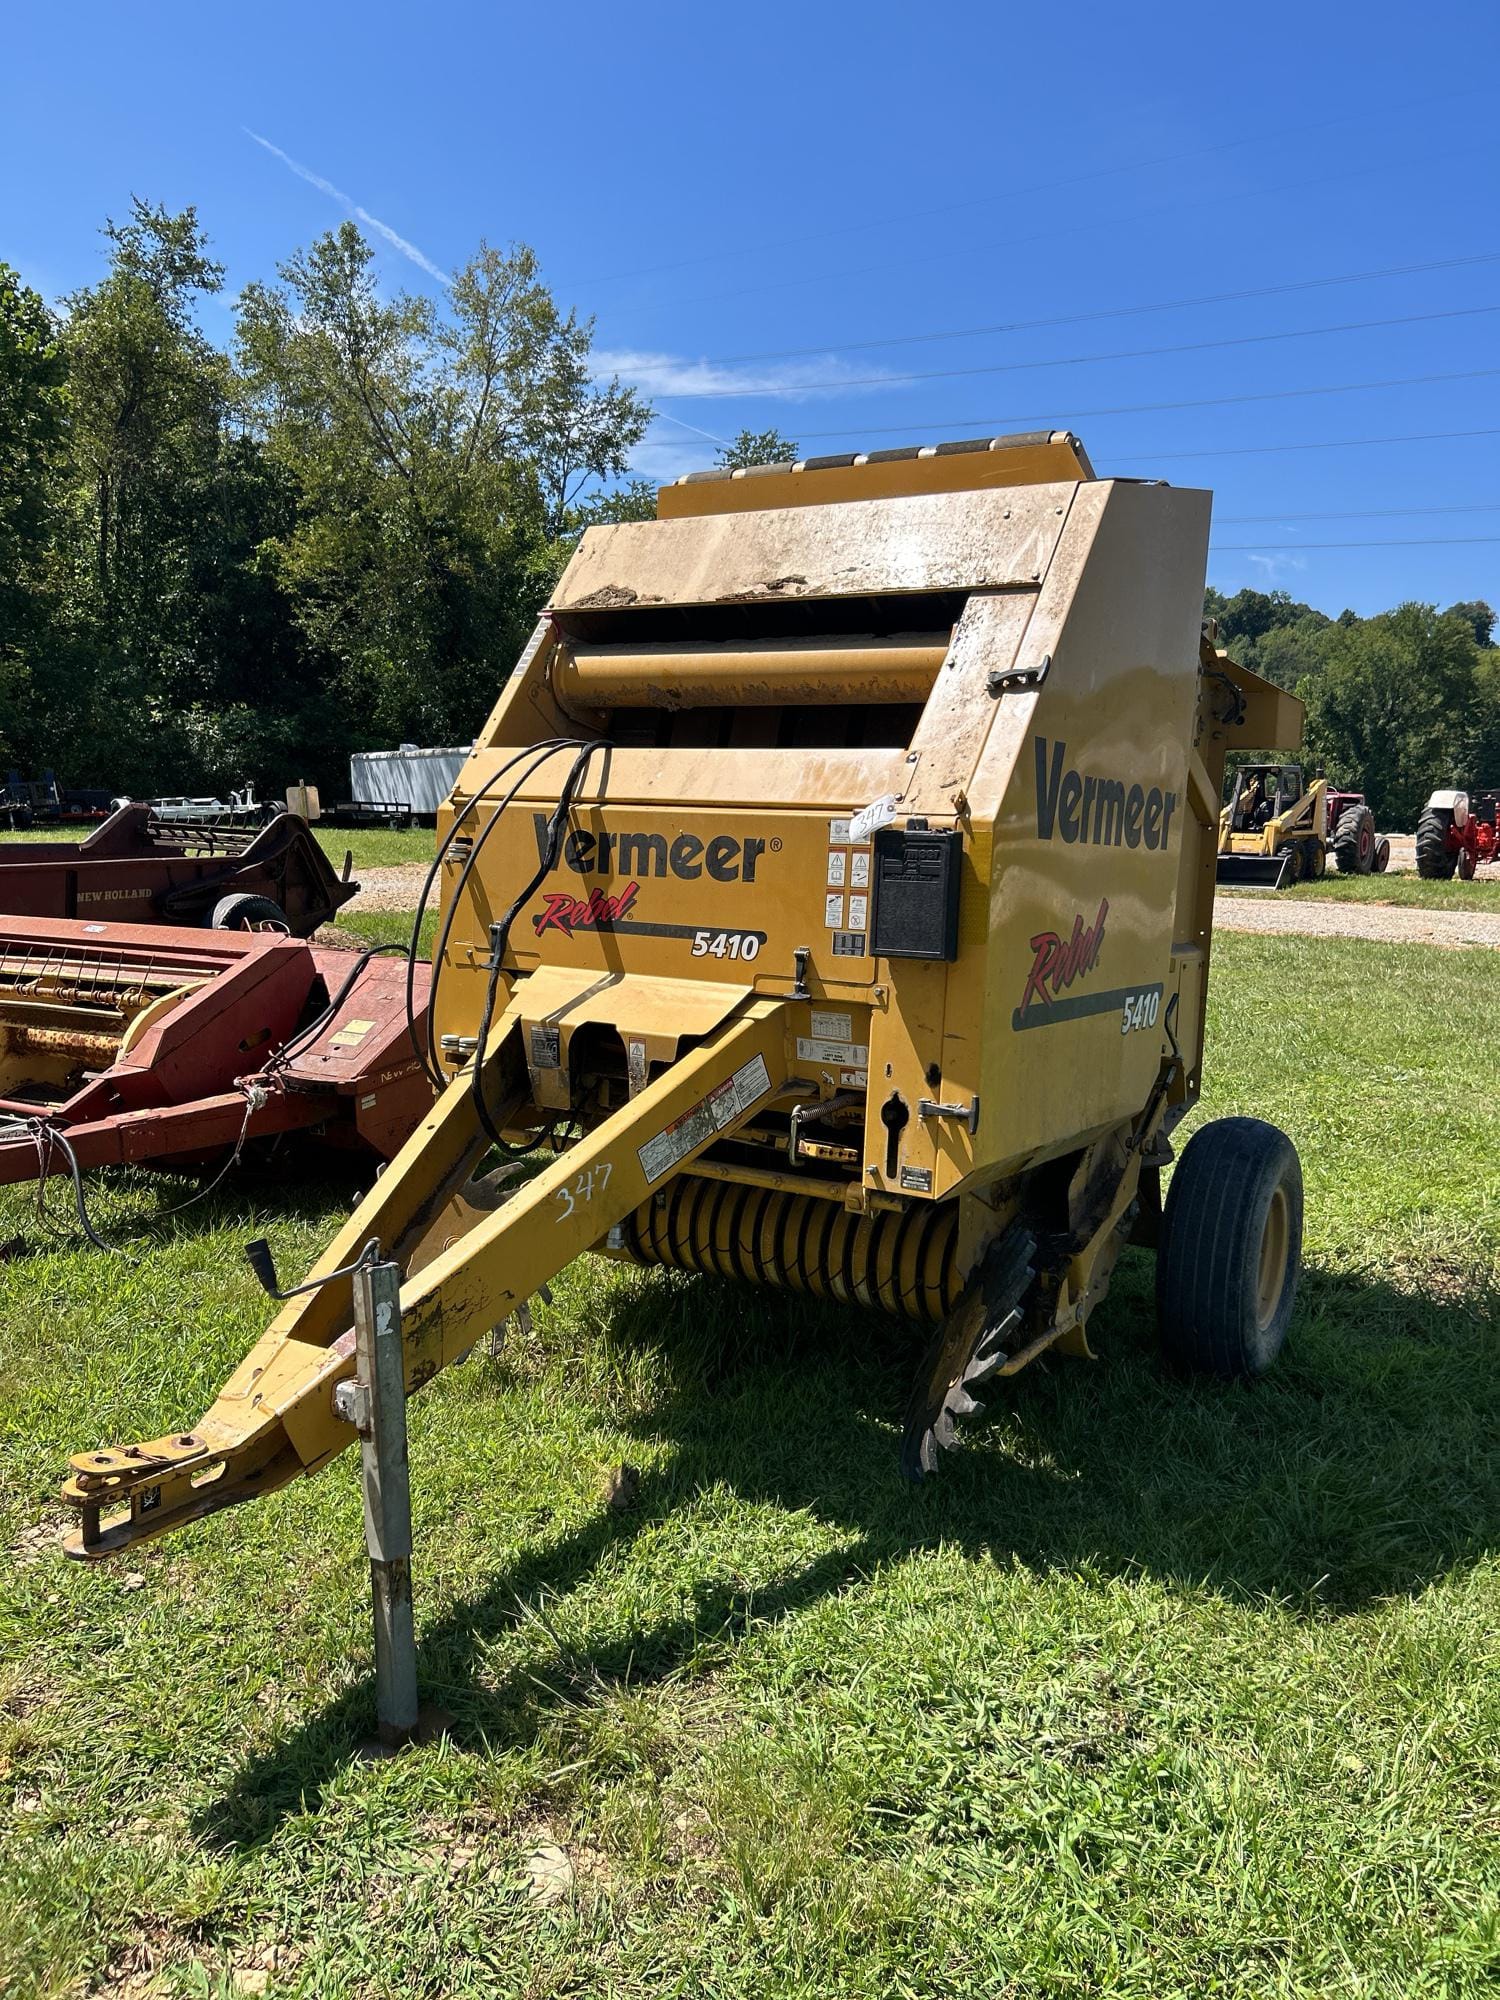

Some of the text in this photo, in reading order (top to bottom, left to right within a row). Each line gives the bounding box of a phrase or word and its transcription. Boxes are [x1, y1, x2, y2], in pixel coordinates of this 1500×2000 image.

[857, 803, 884, 834] 347
[1035, 736, 1177, 850] Vermeer
[533, 813, 766, 883] Vermeer
[76, 888, 153, 902] NEW HOLLAND
[535, 880, 641, 940] Rebel
[691, 931, 760, 961] 5410
[1020, 897, 1110, 1019] Rebel
[1121, 990, 1160, 1036] 5410
[555, 1162, 613, 1224] 347
